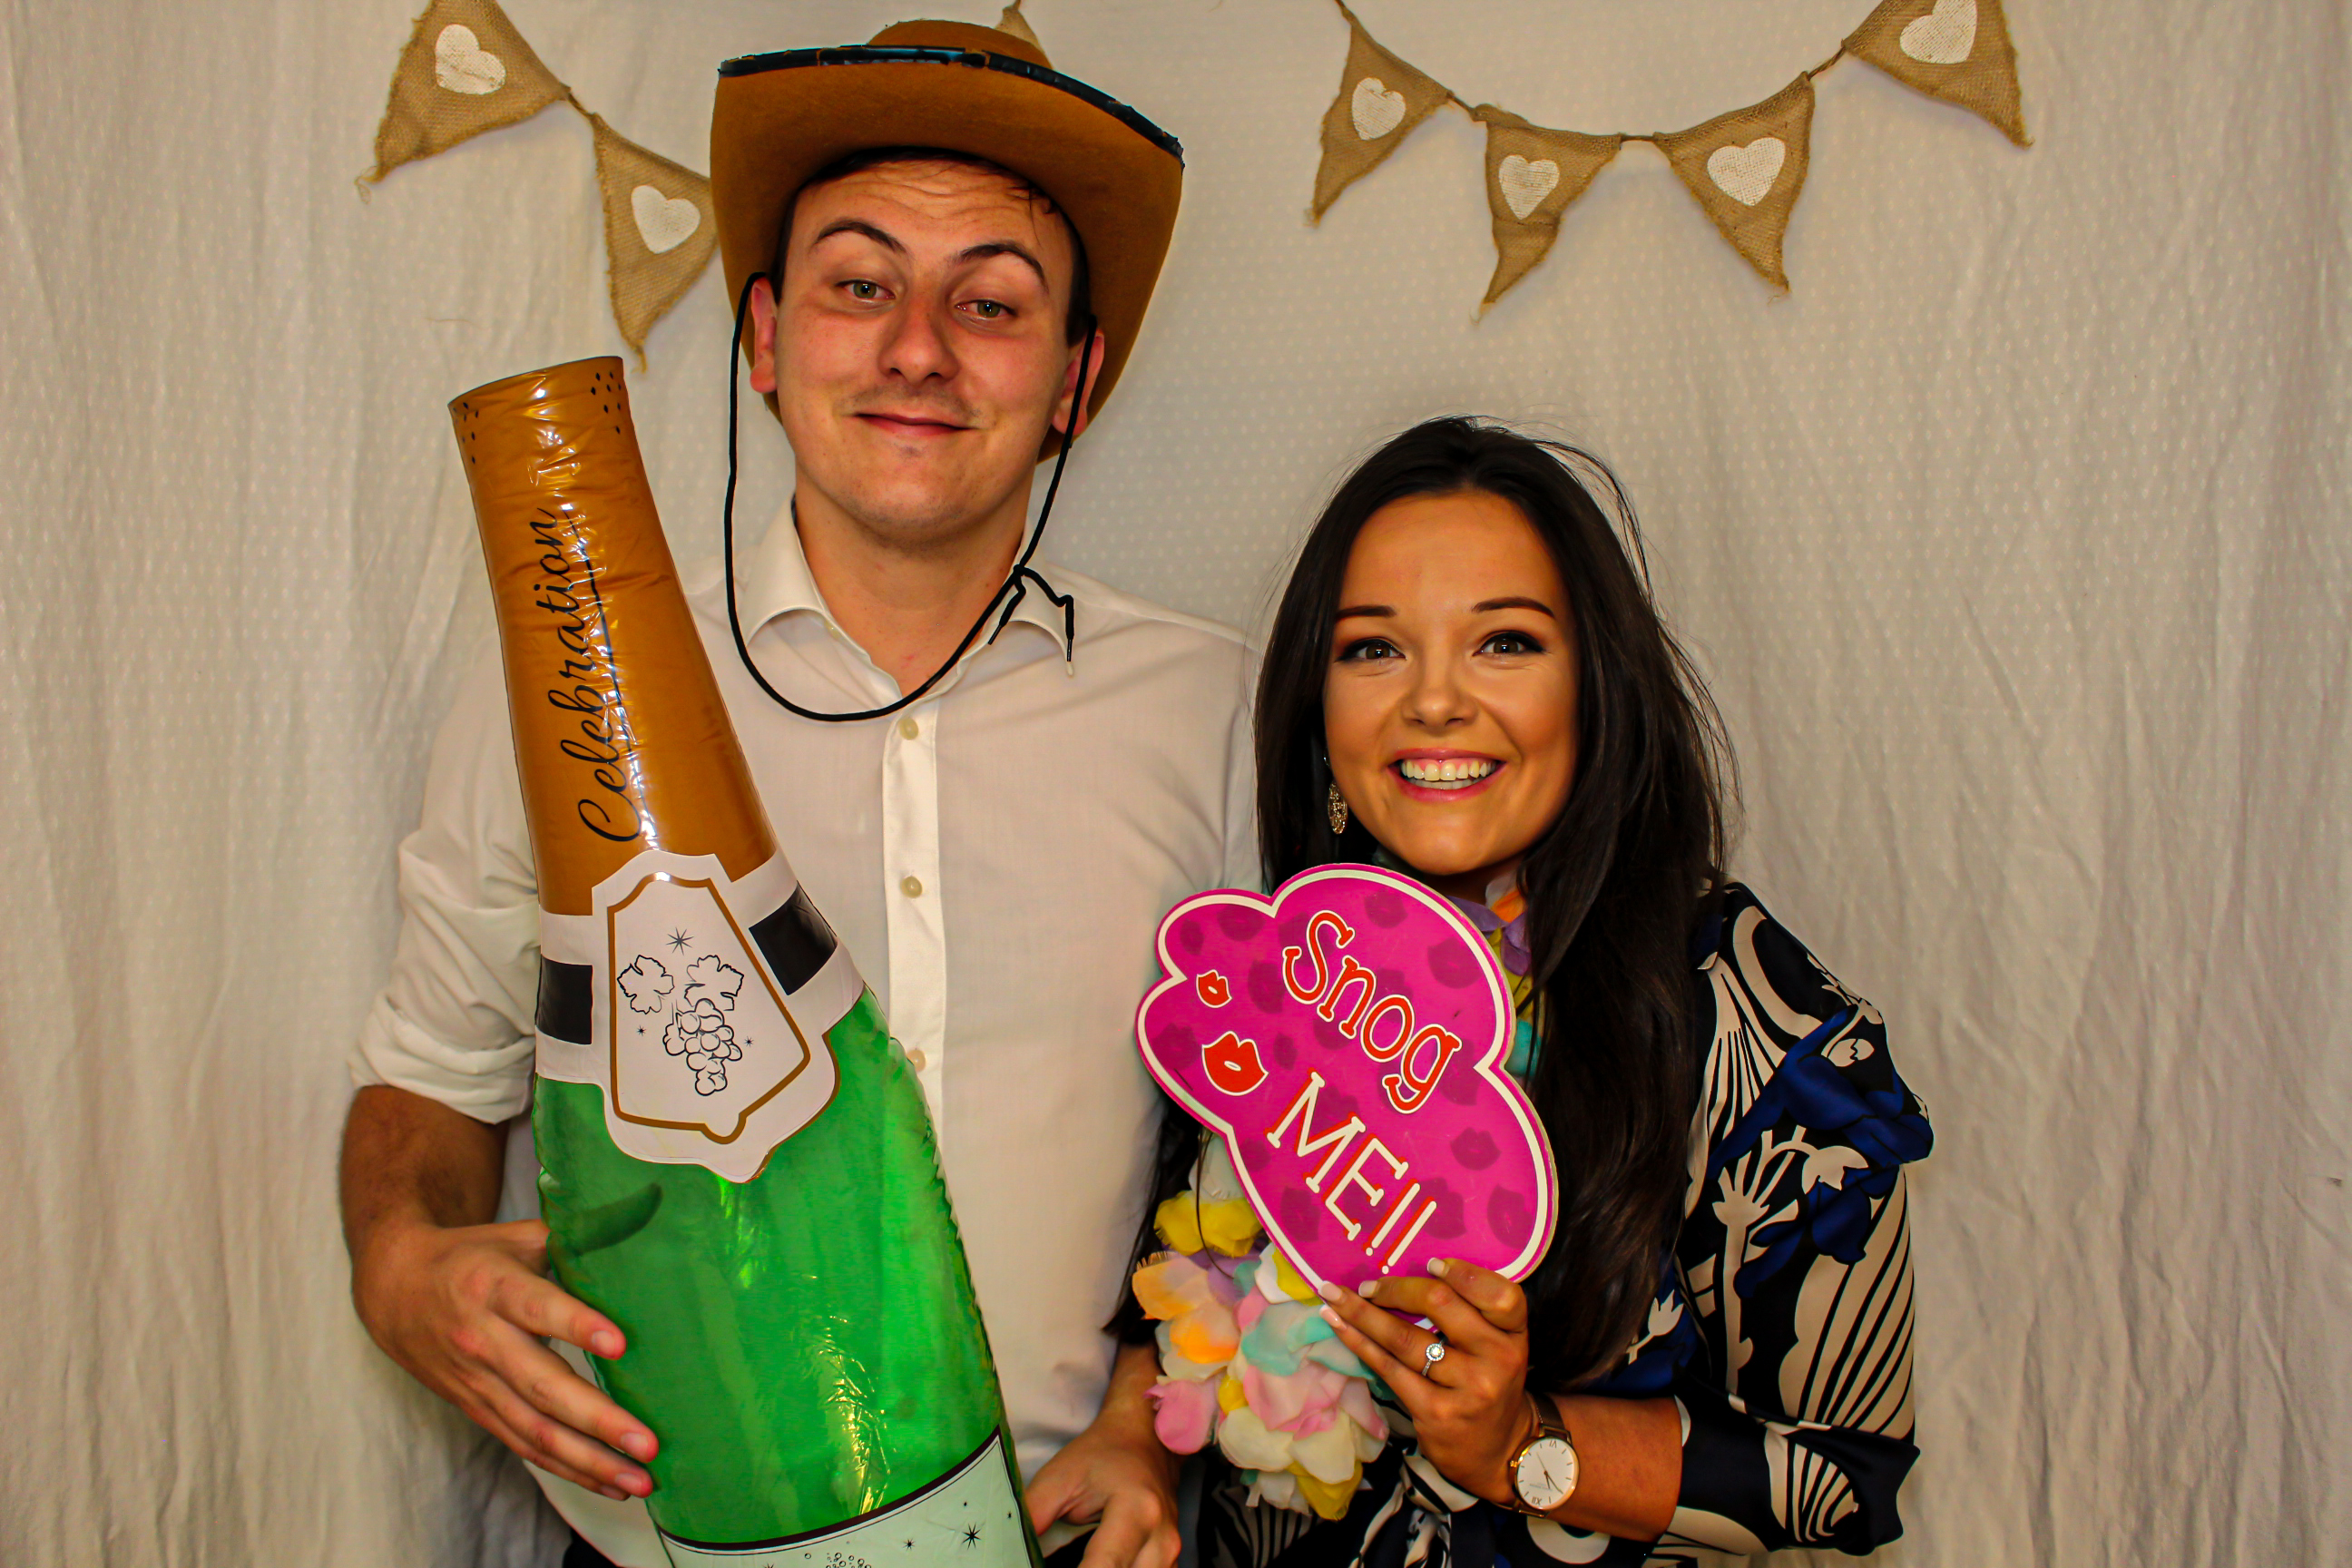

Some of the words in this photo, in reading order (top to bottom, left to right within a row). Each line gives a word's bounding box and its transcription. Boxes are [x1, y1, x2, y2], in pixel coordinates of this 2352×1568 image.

[530, 507, 642, 842] Celebration
[1282, 910, 1462, 1114] Snog
[1264, 1067, 1437, 1274] ME!!
[1532, 1496, 1543, 1506] XII
